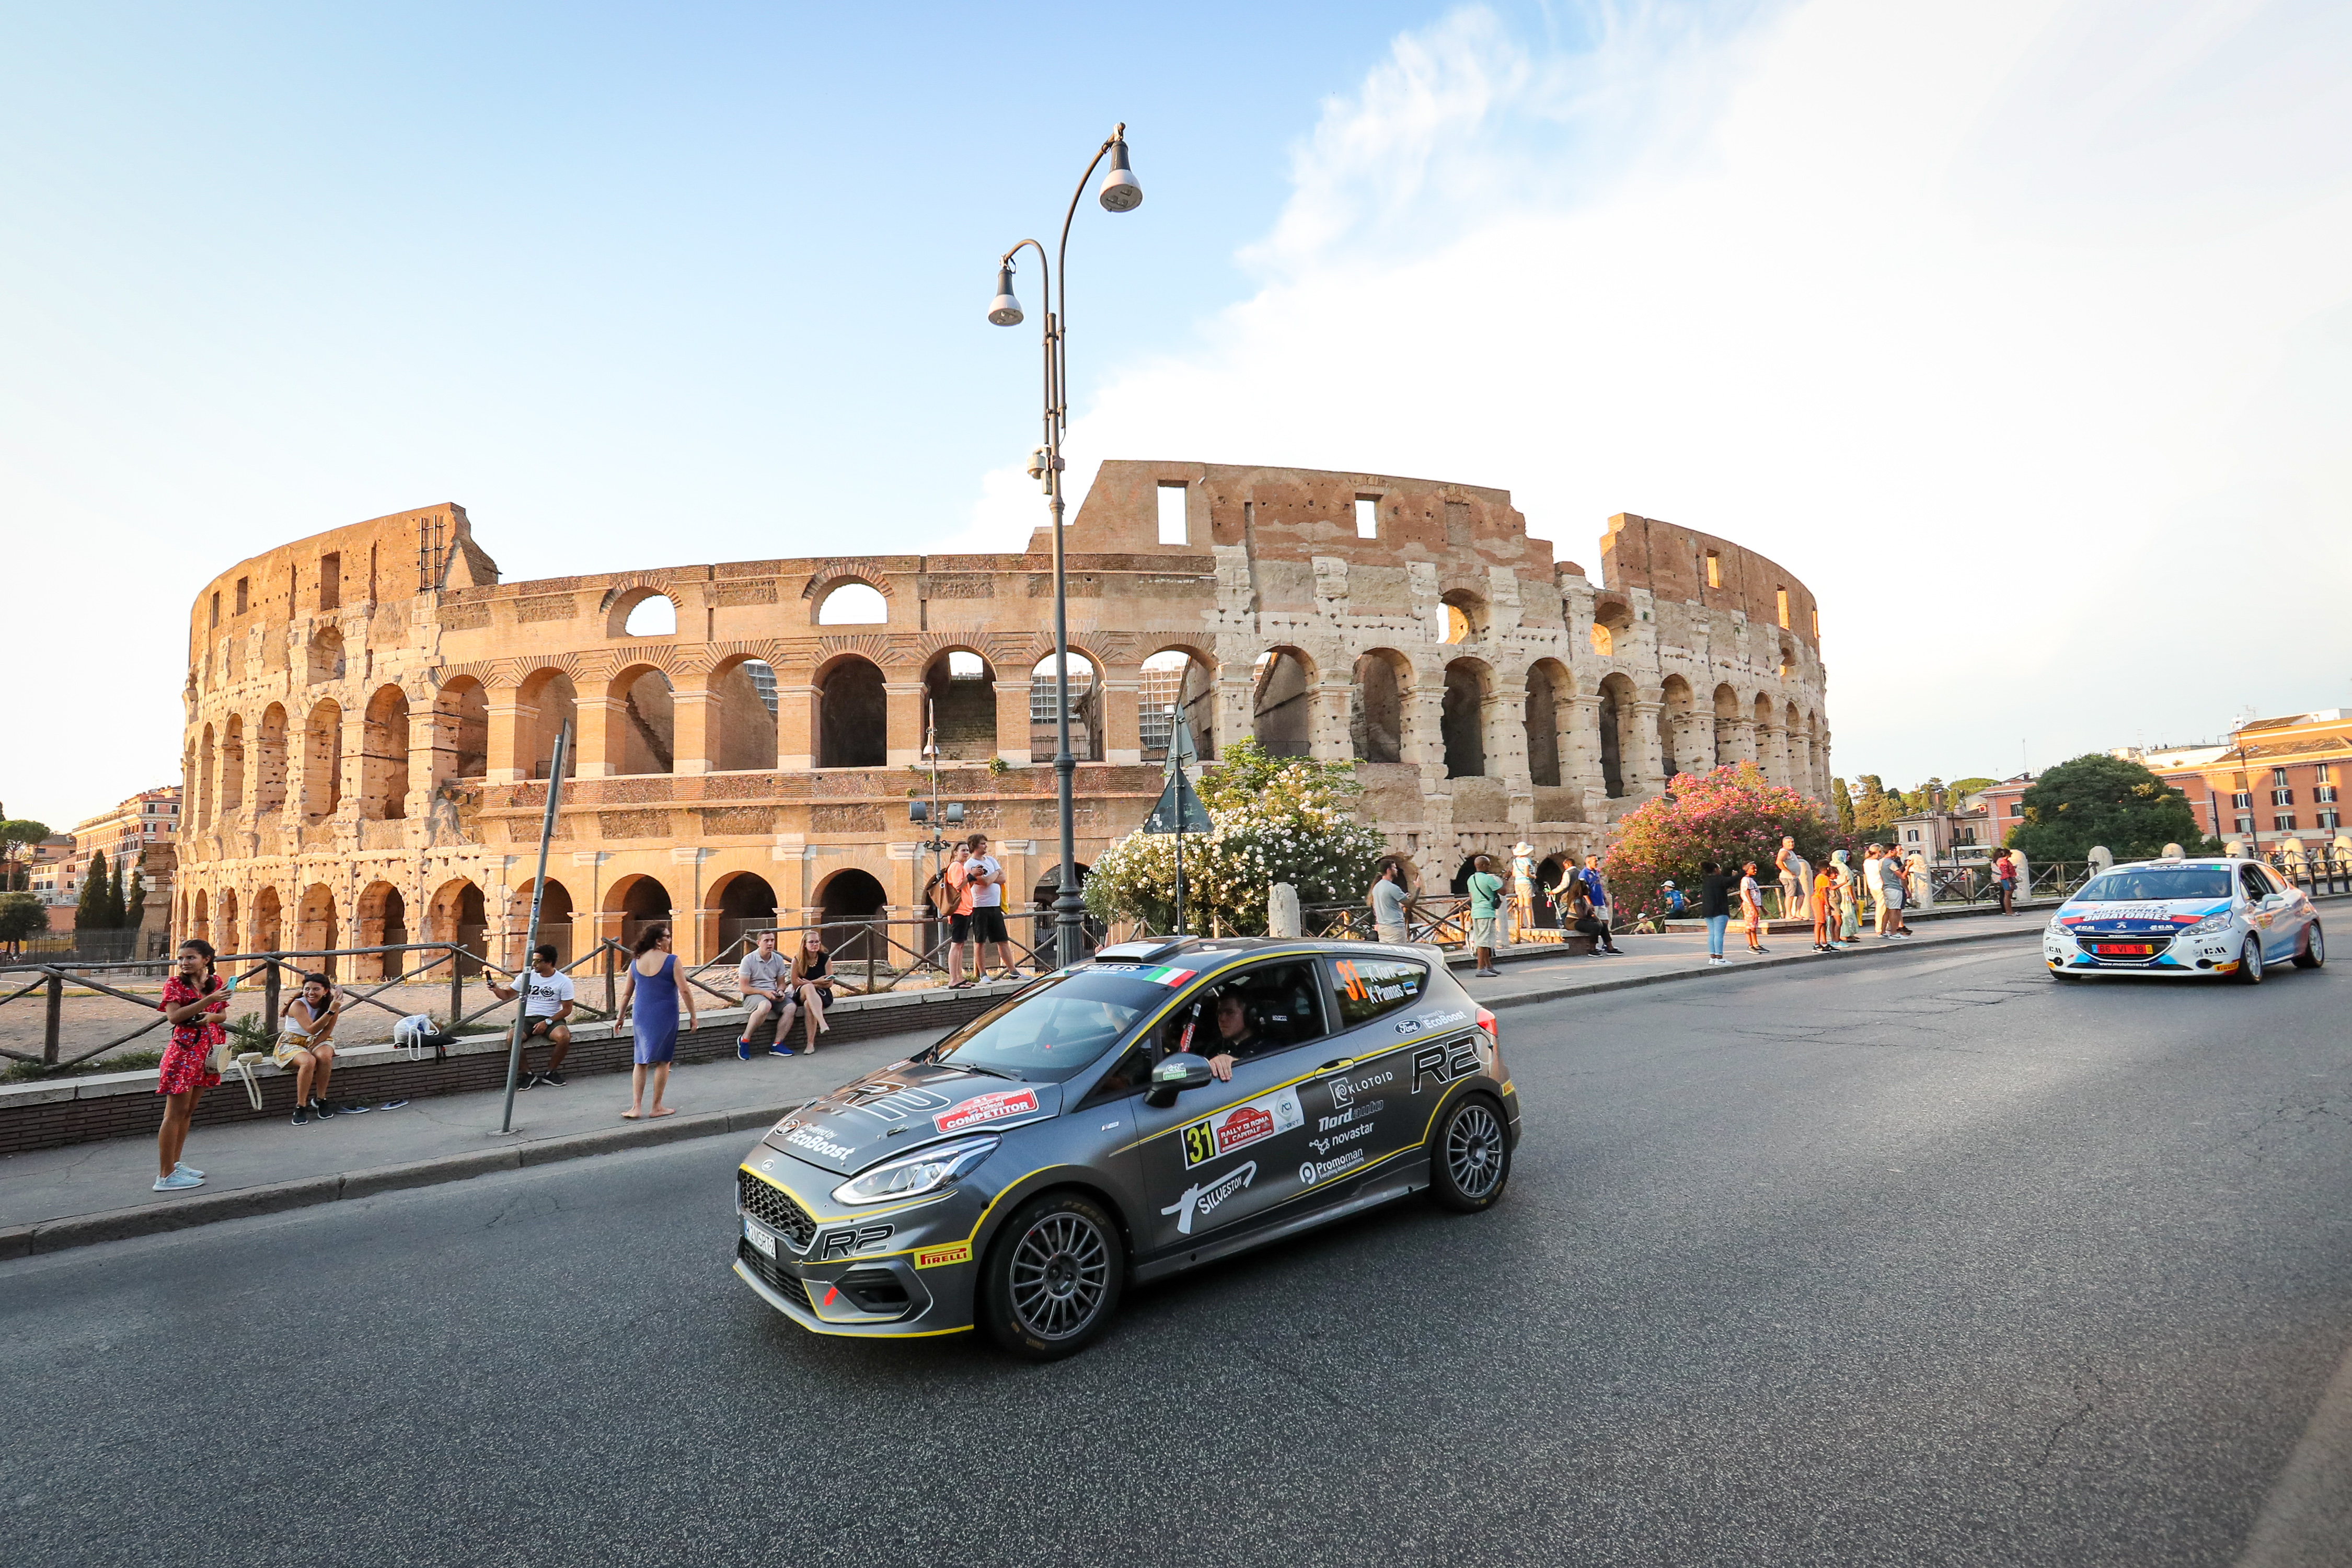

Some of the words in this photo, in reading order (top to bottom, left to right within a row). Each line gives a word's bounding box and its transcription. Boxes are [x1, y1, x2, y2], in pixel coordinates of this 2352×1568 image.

[1335, 960, 1368, 1001] 31
[1365, 966, 1378, 983] K
[1376, 965, 1397, 981] Torn
[1366, 987, 1379, 1004] K
[1374, 983, 1404, 1002] Pannas
[1419, 1010, 1439, 1019] Powered
[1423, 1010, 1467, 1029] EcoBoost
[1399, 1021, 1419, 1034] Ford
[1411, 1034, 1482, 1094] R2
[1348, 1071, 1393, 1094] KLOTOID
[946, 1101, 1030, 1128] COMPETITOR
[1220, 1125, 1242, 1138] RALLY
[1250, 1115, 1270, 1127] ROMA
[786, 1129, 857, 1161] EcoBoost
[1187, 1122, 1214, 1163] 31
[1332, 1122, 1374, 1146] novastar
[1316, 1148, 1363, 1174] Promoman
[1197, 1175, 1242, 1215] SILVESTON
[820, 1223, 895, 1261] R2
[920, 1248, 967, 1265] PIRELLI
